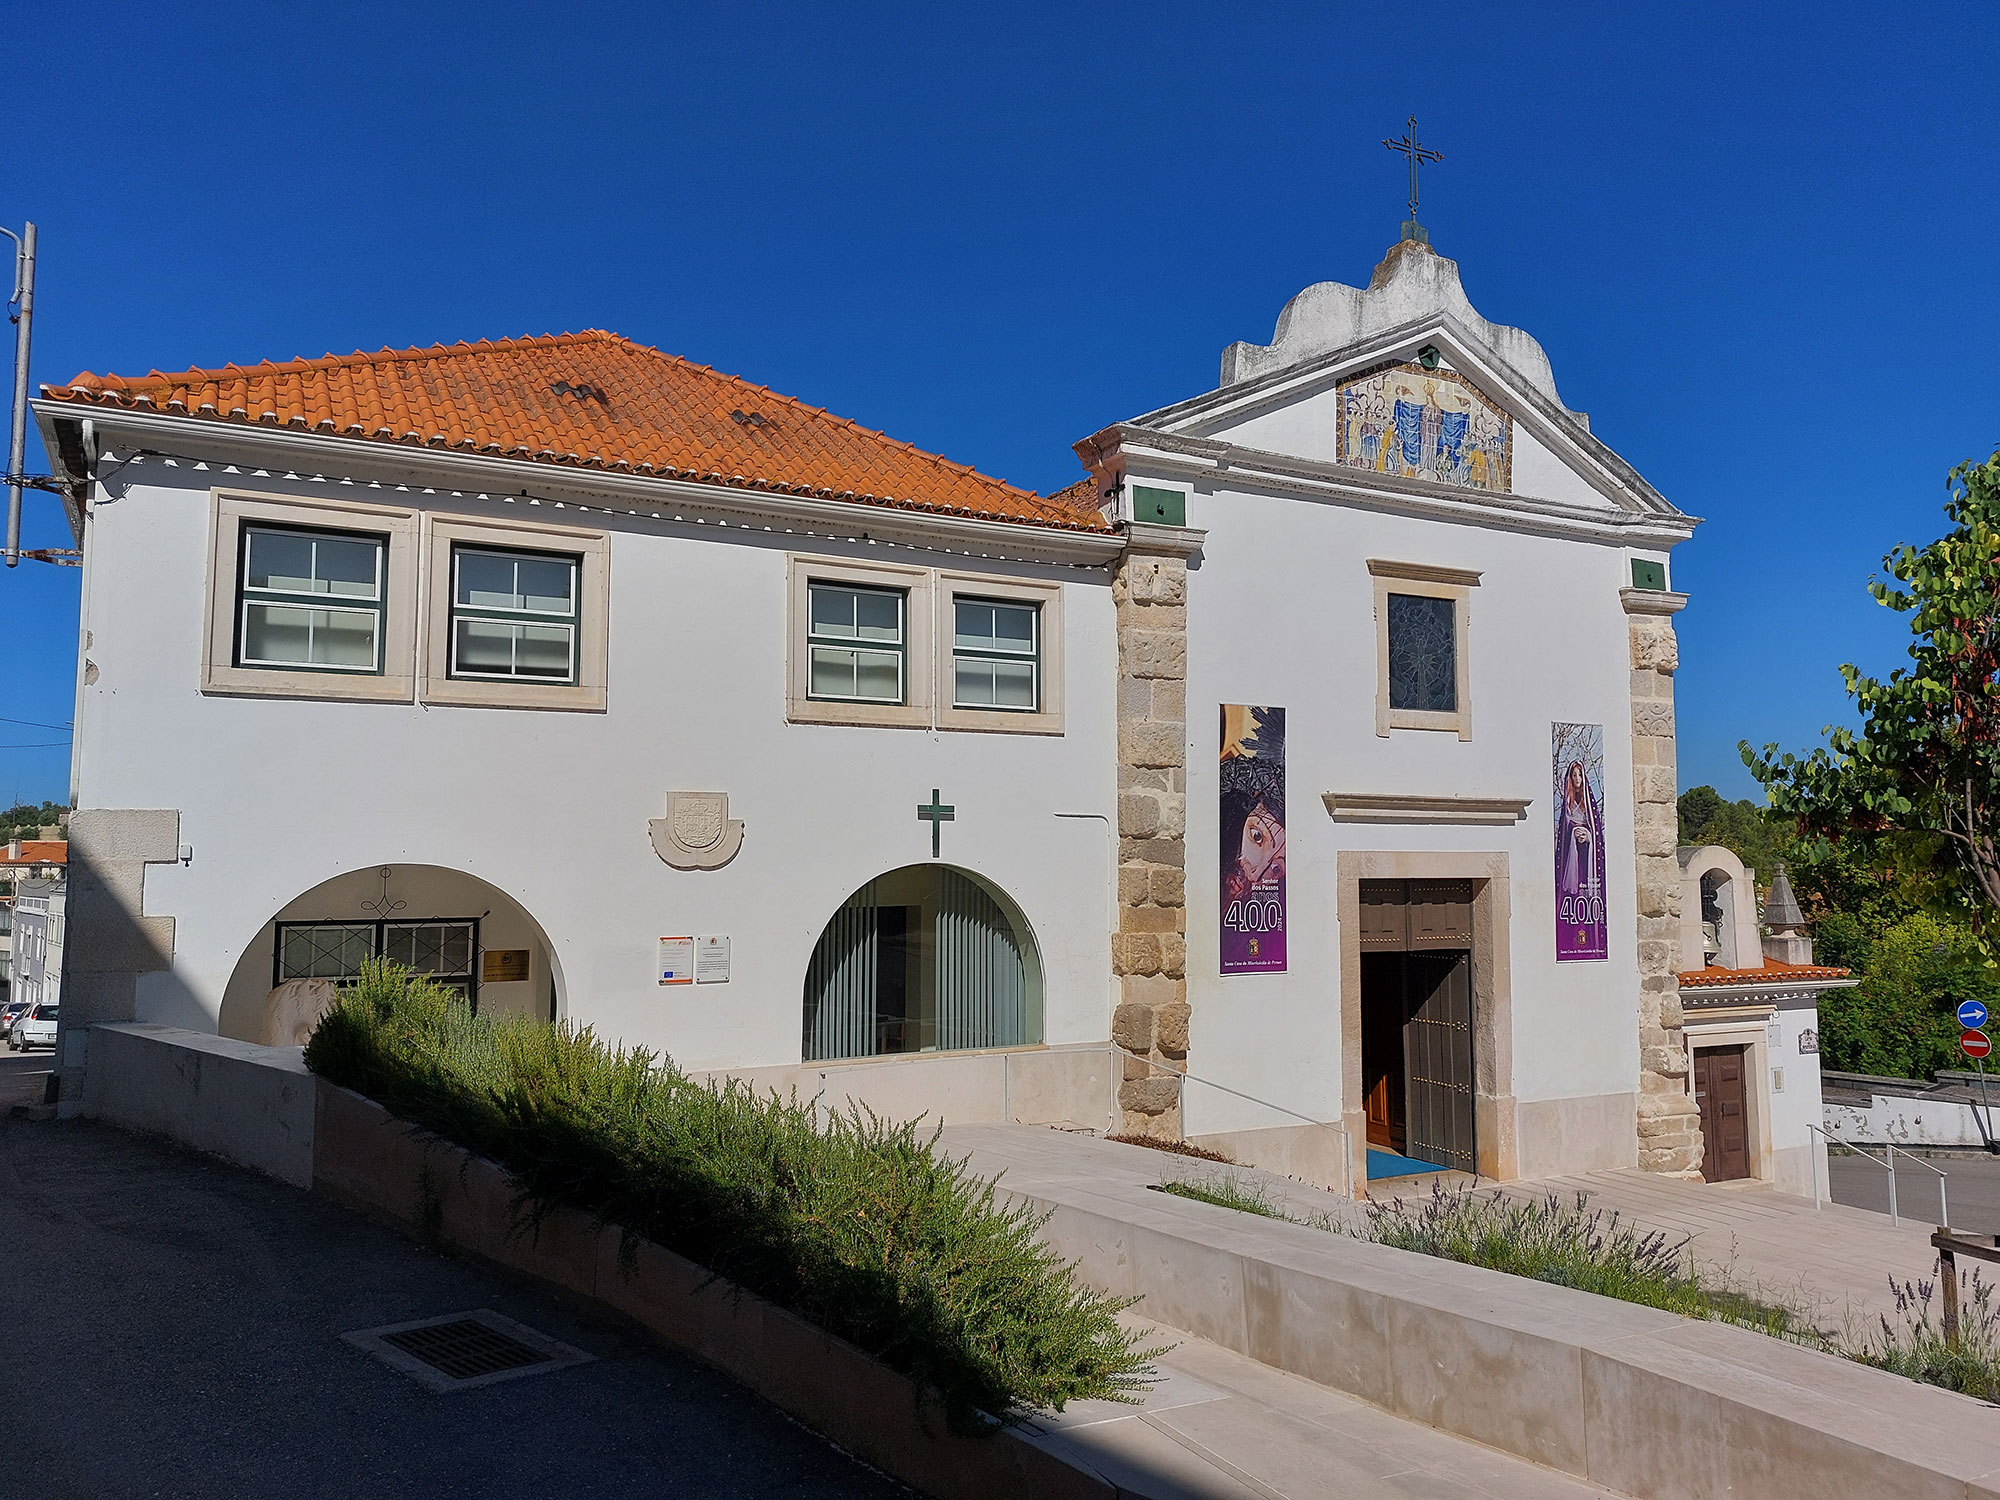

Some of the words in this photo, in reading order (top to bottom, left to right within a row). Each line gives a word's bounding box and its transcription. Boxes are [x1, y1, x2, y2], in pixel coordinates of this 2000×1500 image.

[1251, 883, 1261, 891] dos
[1251, 891, 1280, 901] anos
[1224, 900, 1283, 932] 400
[1560, 896, 1604, 925] 400
